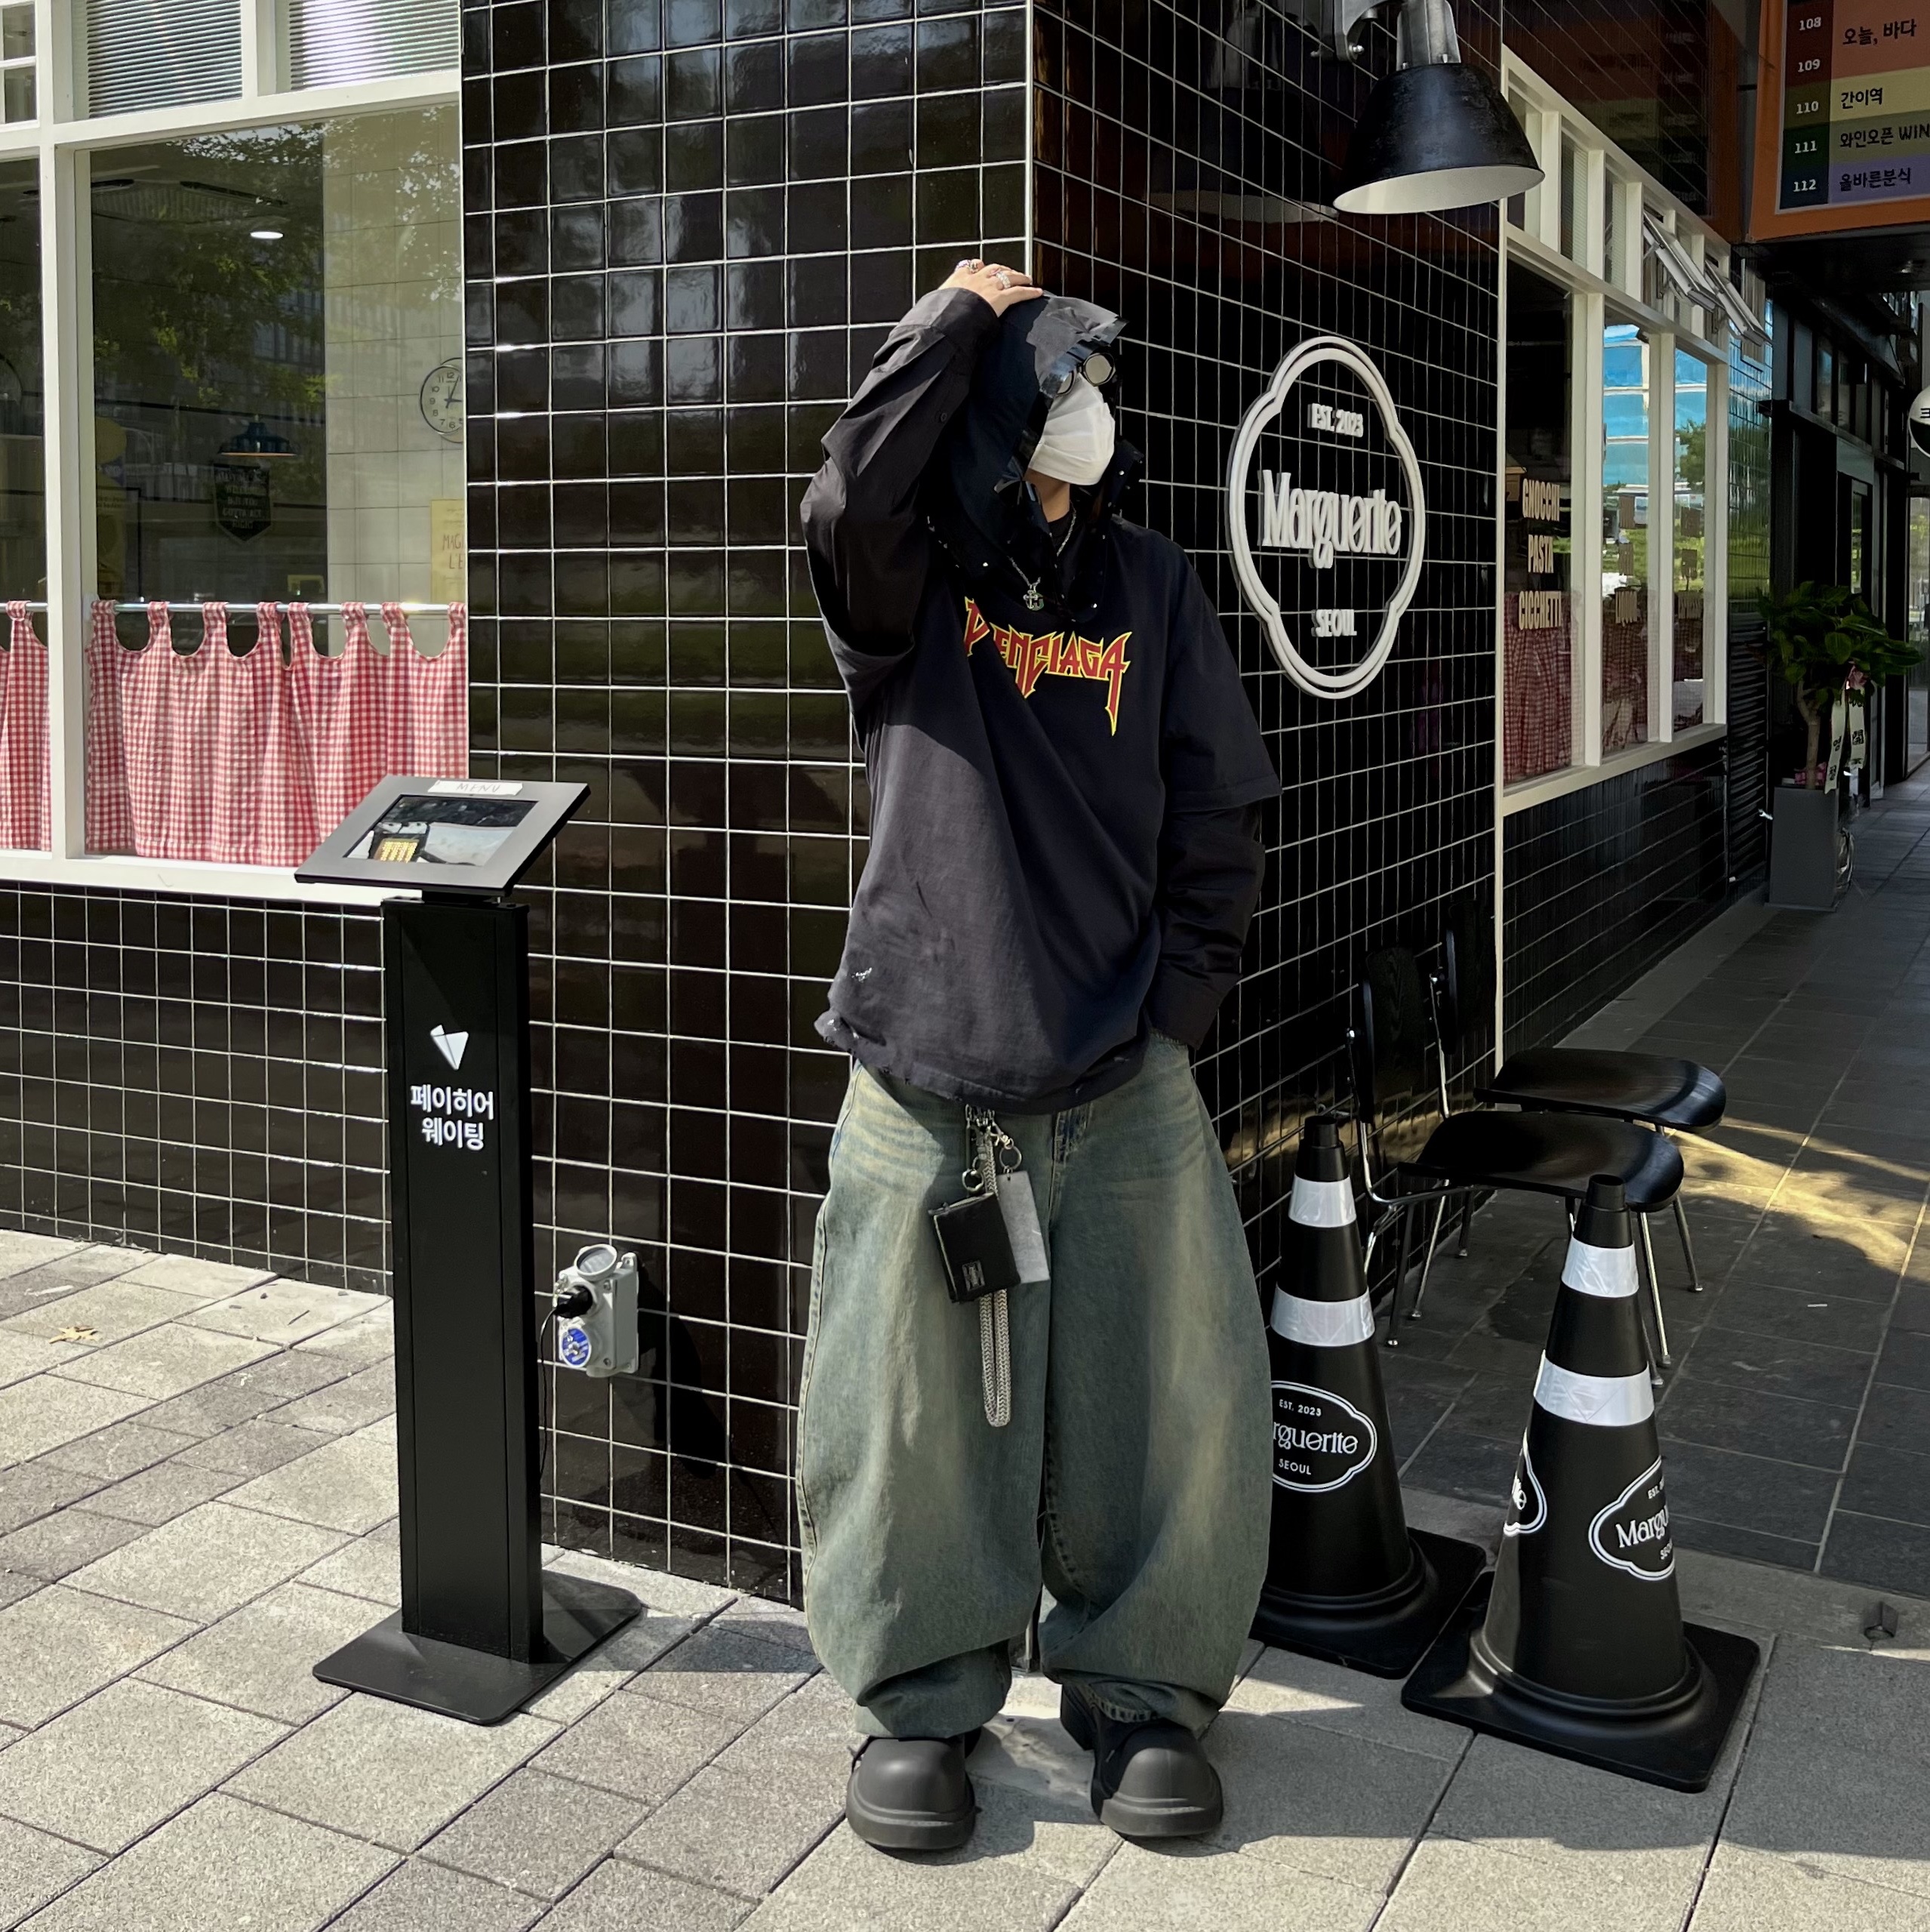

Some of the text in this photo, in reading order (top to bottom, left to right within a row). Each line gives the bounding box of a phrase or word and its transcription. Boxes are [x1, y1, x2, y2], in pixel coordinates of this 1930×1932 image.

[1799, 17, 1822, 31] 108
[1842, 19, 1917, 45] 오늘, 바다
[1797, 58, 1821, 72] 109
[1796, 100, 1819, 115] 110
[1840, 87, 1884, 109] 간이역
[1794, 140, 1818, 154] 111
[1839, 127, 1894, 148] 와인오픈
[1793, 179, 1817, 193] 112
[1839, 167, 1911, 192] 올바른분식
[1335, 408, 1364, 438] 2023
[1522, 477, 1560, 522] GNOCCHI
[1261, 469, 1402, 569] Marguerite
[1528, 533, 1554, 574] PASTA
[1315, 609, 1358, 638] SEOUL
[456, 782, 501, 793] MENU
[410, 1083, 494, 1120] 페이히어
[421, 1117, 485, 1151] 웨이팅
[1279, 1398, 1322, 1417] EST. 2023
[1278, 1458, 1312, 1476] SEOUL
